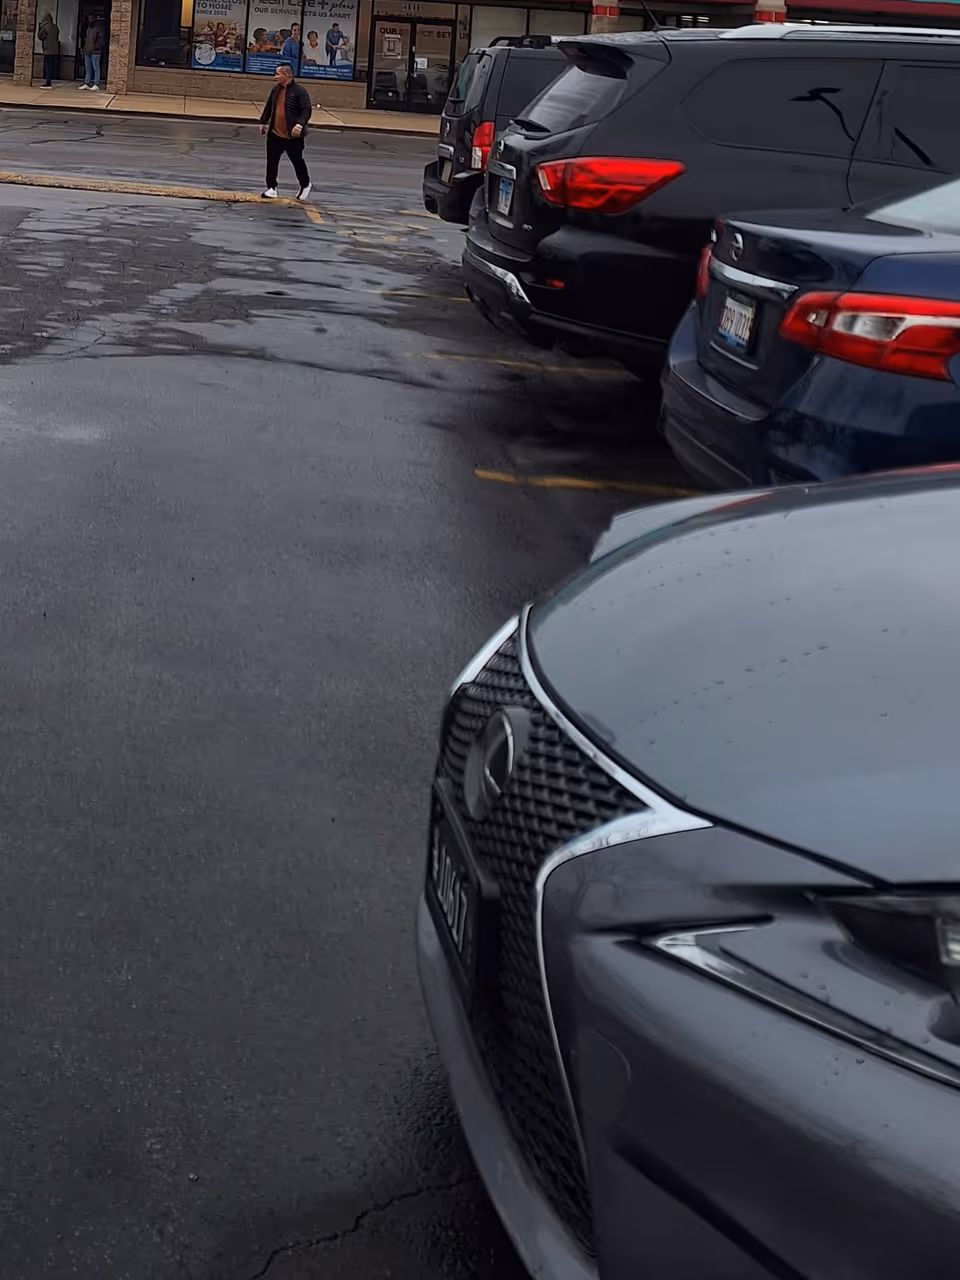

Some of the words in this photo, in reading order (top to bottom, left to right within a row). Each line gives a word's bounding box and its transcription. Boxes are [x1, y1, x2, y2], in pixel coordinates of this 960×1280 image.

[208, 2, 233, 11] HOME
[269, 8, 298, 16] SERVICE
[328, 12, 351, 20] APART
